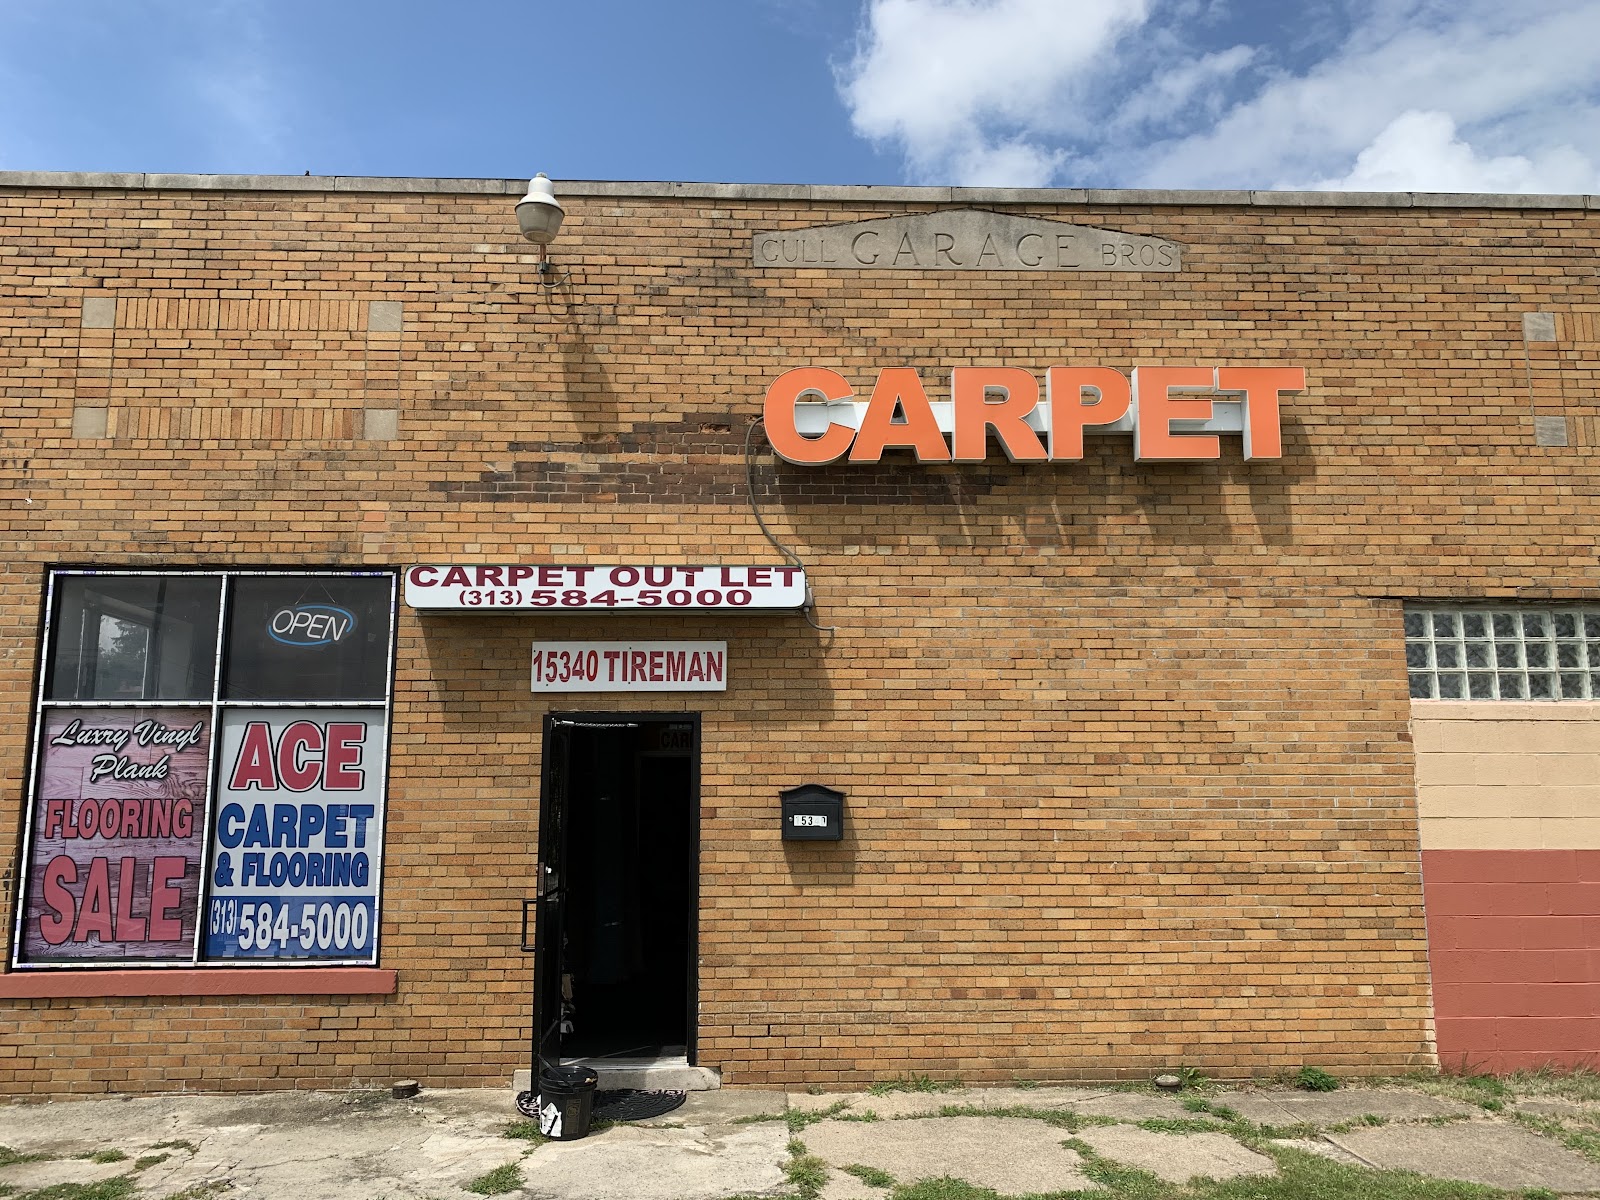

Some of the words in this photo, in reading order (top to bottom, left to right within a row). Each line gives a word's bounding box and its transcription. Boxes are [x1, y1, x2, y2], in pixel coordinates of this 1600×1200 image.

[762, 239, 837, 263] GULL
[851, 230, 1081, 269] GARAGE
[1102, 244, 1174, 267] BROS
[763, 366, 1306, 463] CARPET
[409, 566, 594, 588] CARPET
[459, 590, 523, 607] (313)
[531, 590, 753, 607] 584-5000
[272, 609, 348, 641] OPEN
[533, 650, 599, 683] 15340
[603, 650, 723, 682] TIREMAN
[51, 719, 130, 752] Luxry
[133, 720, 201, 751] Vinyl
[89, 754, 170, 784] Plank
[229, 720, 368, 793] ACE
[44, 798, 194, 840] FLOORING
[217, 803, 375, 849] CARPET
[214, 852, 234, 887] &
[240, 852, 369, 888] FLOORING
[39, 855, 187, 945] SALE
[209, 899, 238, 936] (313)
[237, 902, 369, 951] 584-5000
